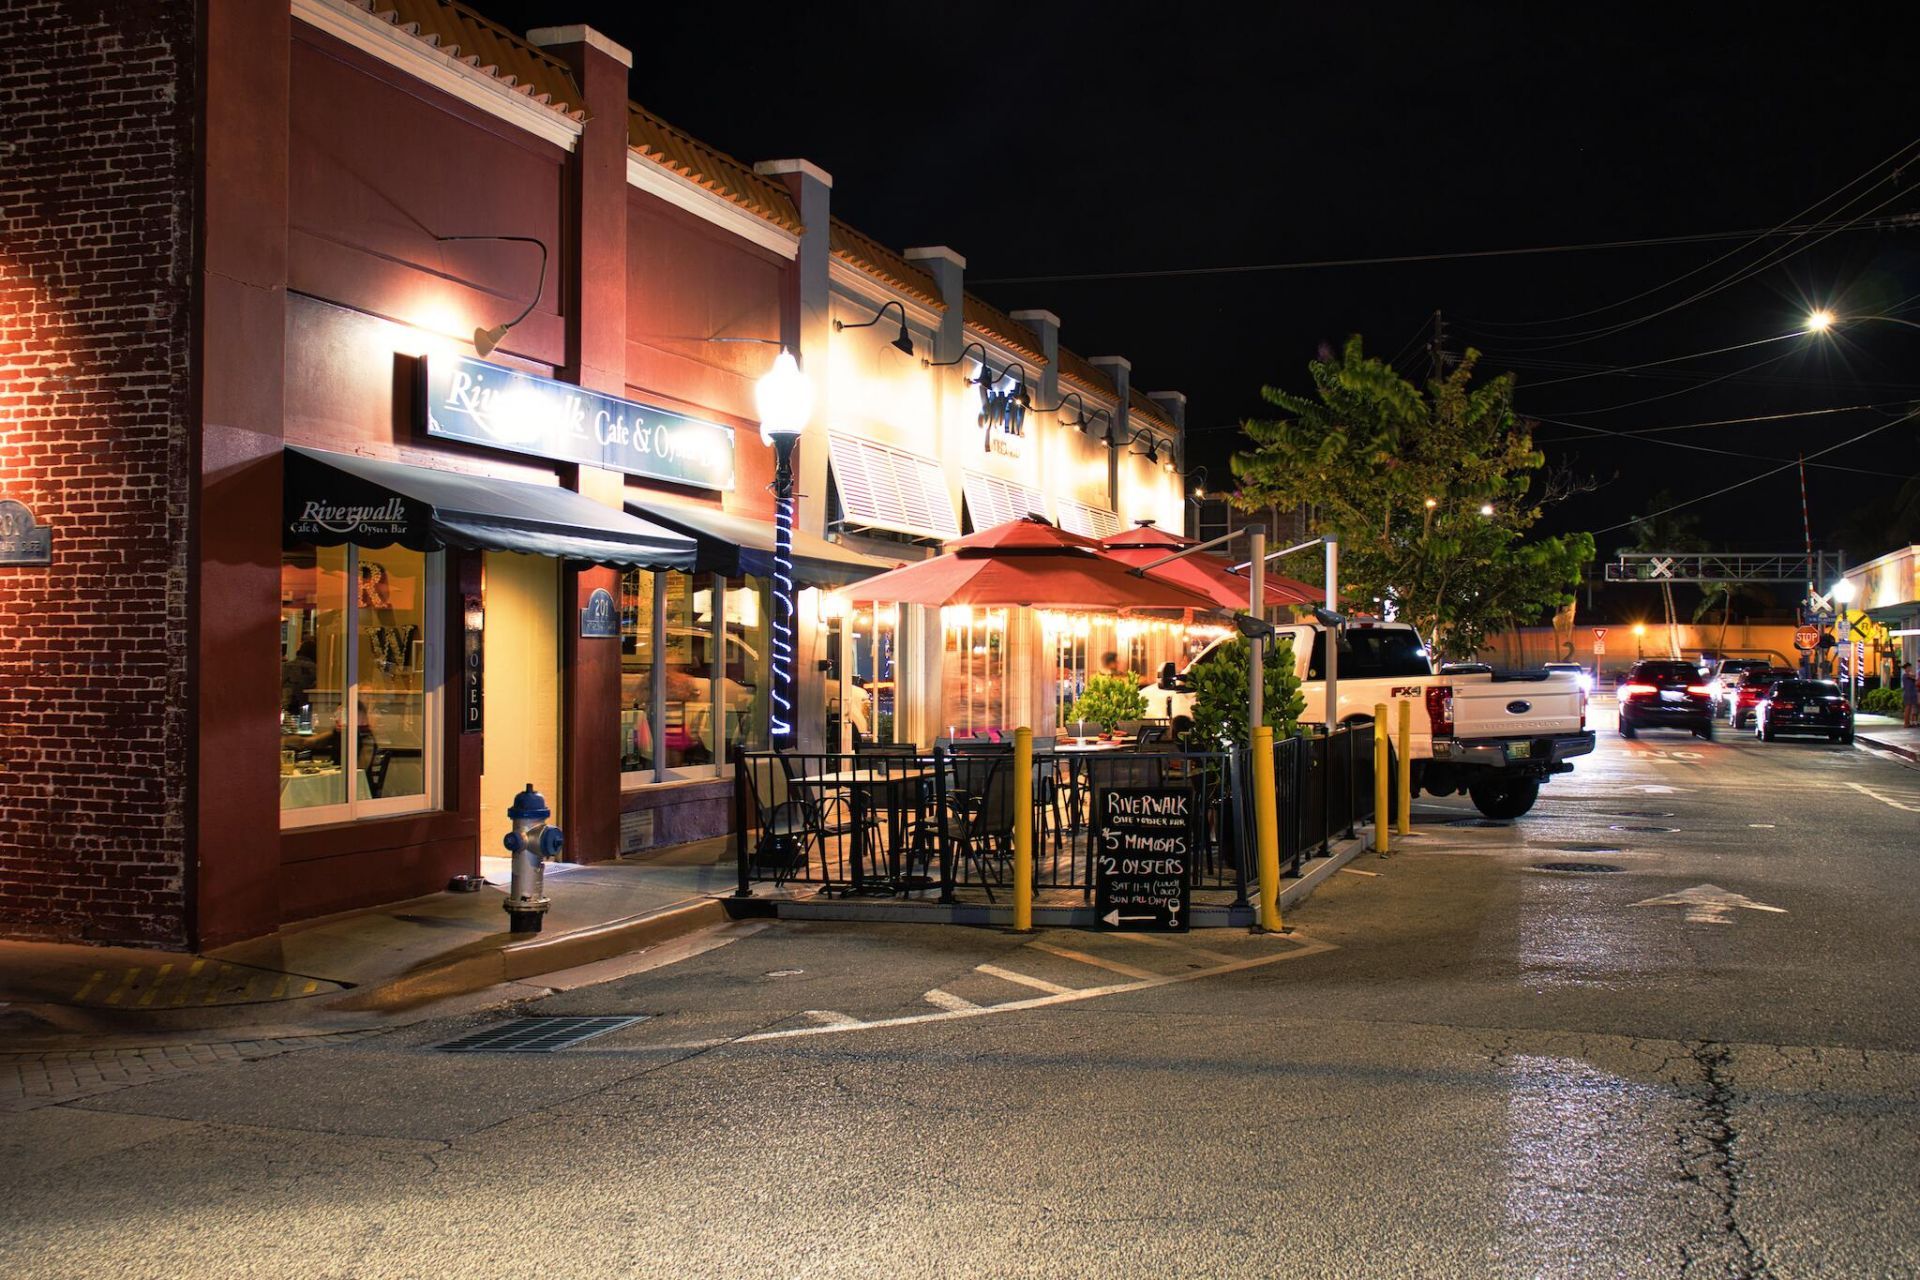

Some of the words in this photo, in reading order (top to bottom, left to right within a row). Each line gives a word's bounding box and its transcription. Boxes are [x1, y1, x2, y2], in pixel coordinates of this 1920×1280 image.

[445, 369, 588, 440] Rivlk
[594, 409, 630, 447] Cafe
[632, 417, 652, 454] &
[300, 497, 407, 533] Riverwalk
[290, 521, 311, 533] Cafe
[391, 523, 408, 533] Bar
[595, 599, 609, 617] 201
[1796, 632, 1818, 641] STOP
[1391, 686, 1422, 698] FX4
[1107, 792, 1189, 816] RIVERWALK
[1124, 834, 1187, 855] MIMOSAS
[1122, 858, 1184, 875] OYSTERS
[1111, 880, 1131, 891] SAT
[1133, 882, 1150, 894] 11-4
[1109, 895, 1129, 904] SUN
[1131, 895, 1147, 904] ALL
[1148, 896, 1168, 908] DAY
